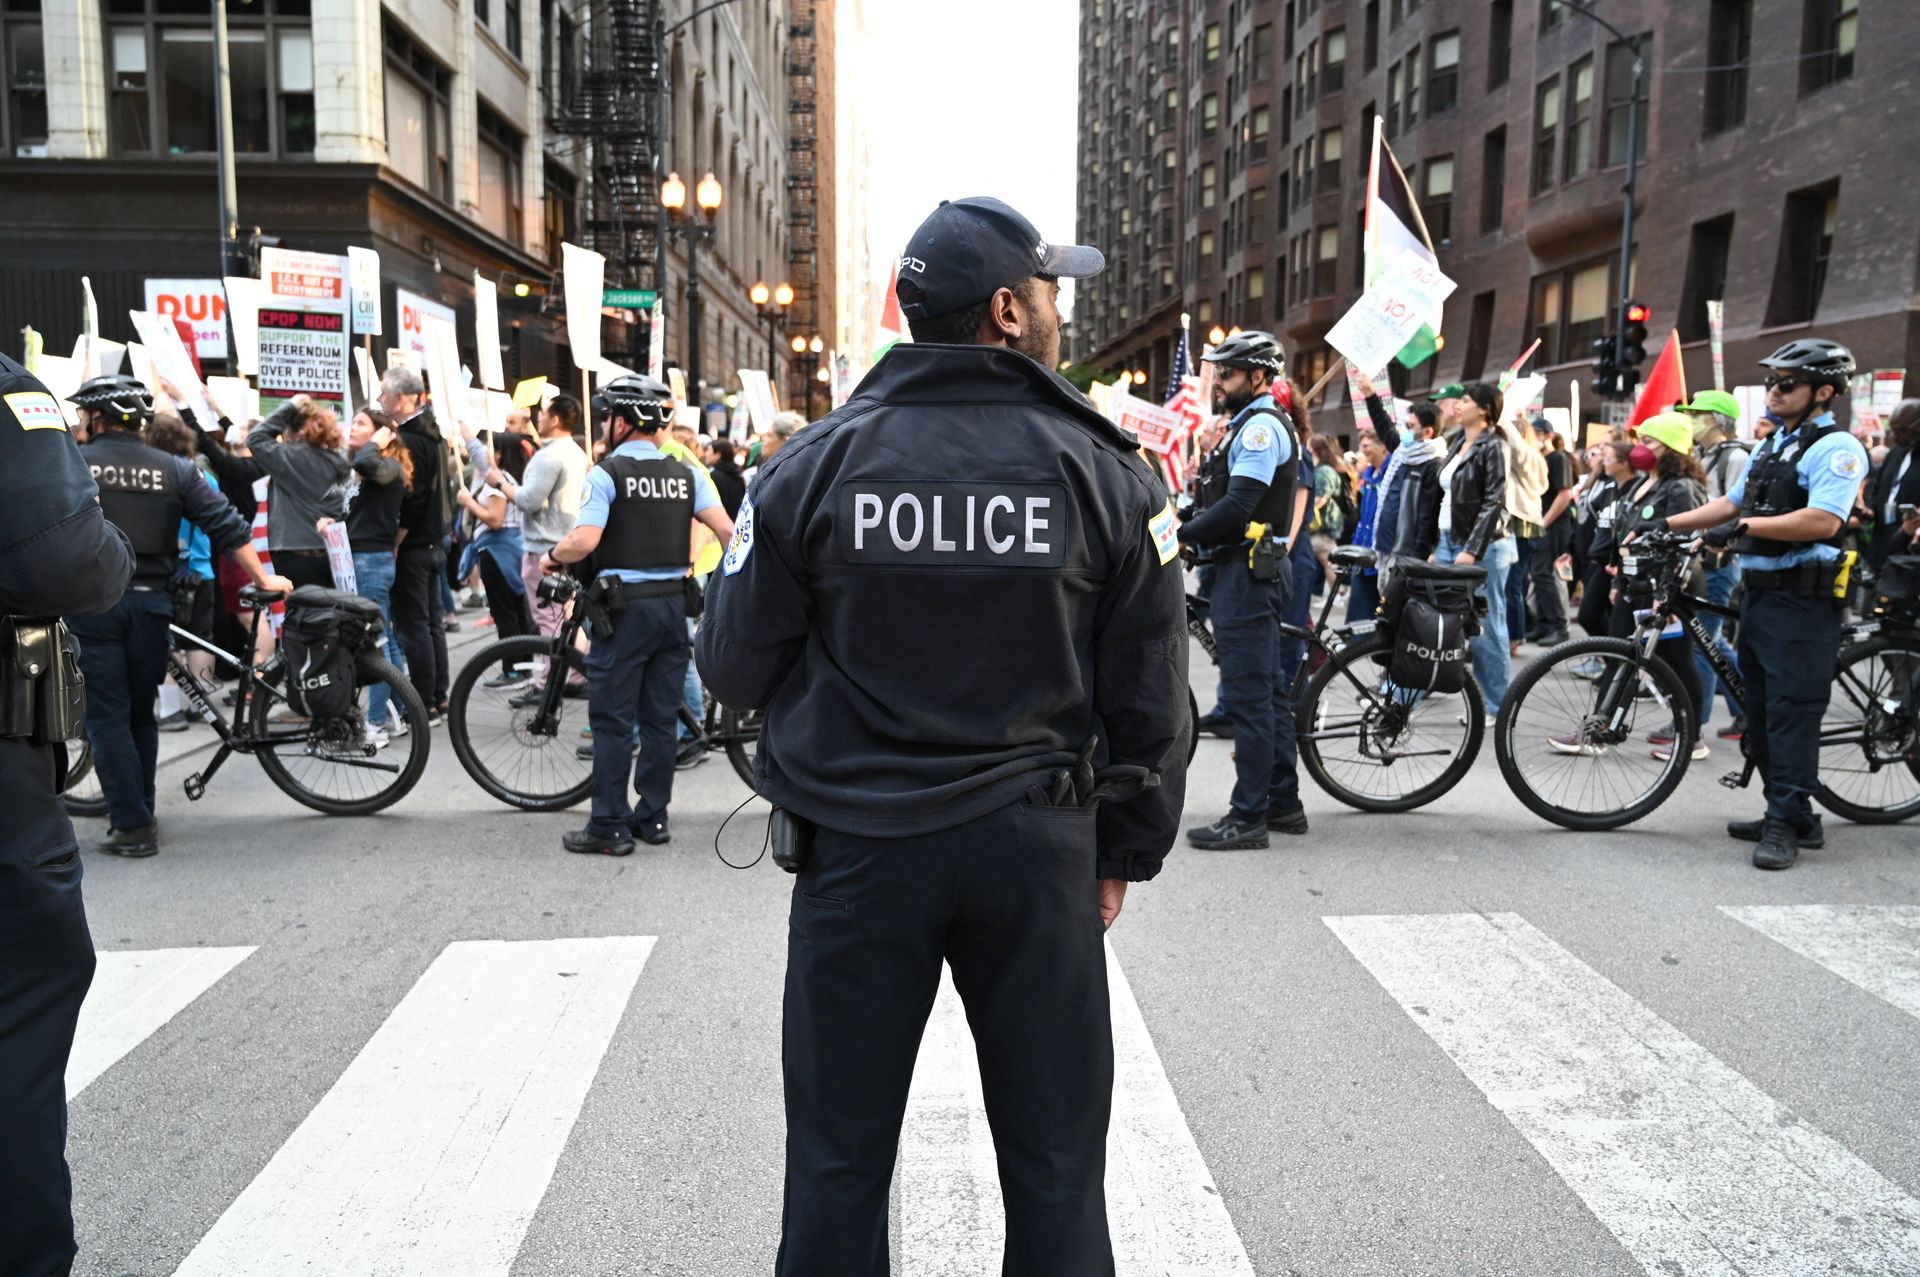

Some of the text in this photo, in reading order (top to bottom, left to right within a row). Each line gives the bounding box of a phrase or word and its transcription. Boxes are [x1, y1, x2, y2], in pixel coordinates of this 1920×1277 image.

[607, 291, 643, 304] Jackson
[260, 311, 341, 330] CPOP NOW!
[260, 330, 340, 345] SUPPORT THE
[260, 343, 341, 358] REFERENDUM
[276, 357, 316, 366] COMMUNITY
[260, 365, 341, 380] OVER POLICE
[90, 465, 163, 490] POLICE
[626, 477, 688, 499] POLICE
[854, 492, 1050, 555] POLICE
[1690, 616, 1722, 663] CHICAGO
[1406, 642, 1462, 662] POLICE
[177, 676, 210, 714] POLICE
